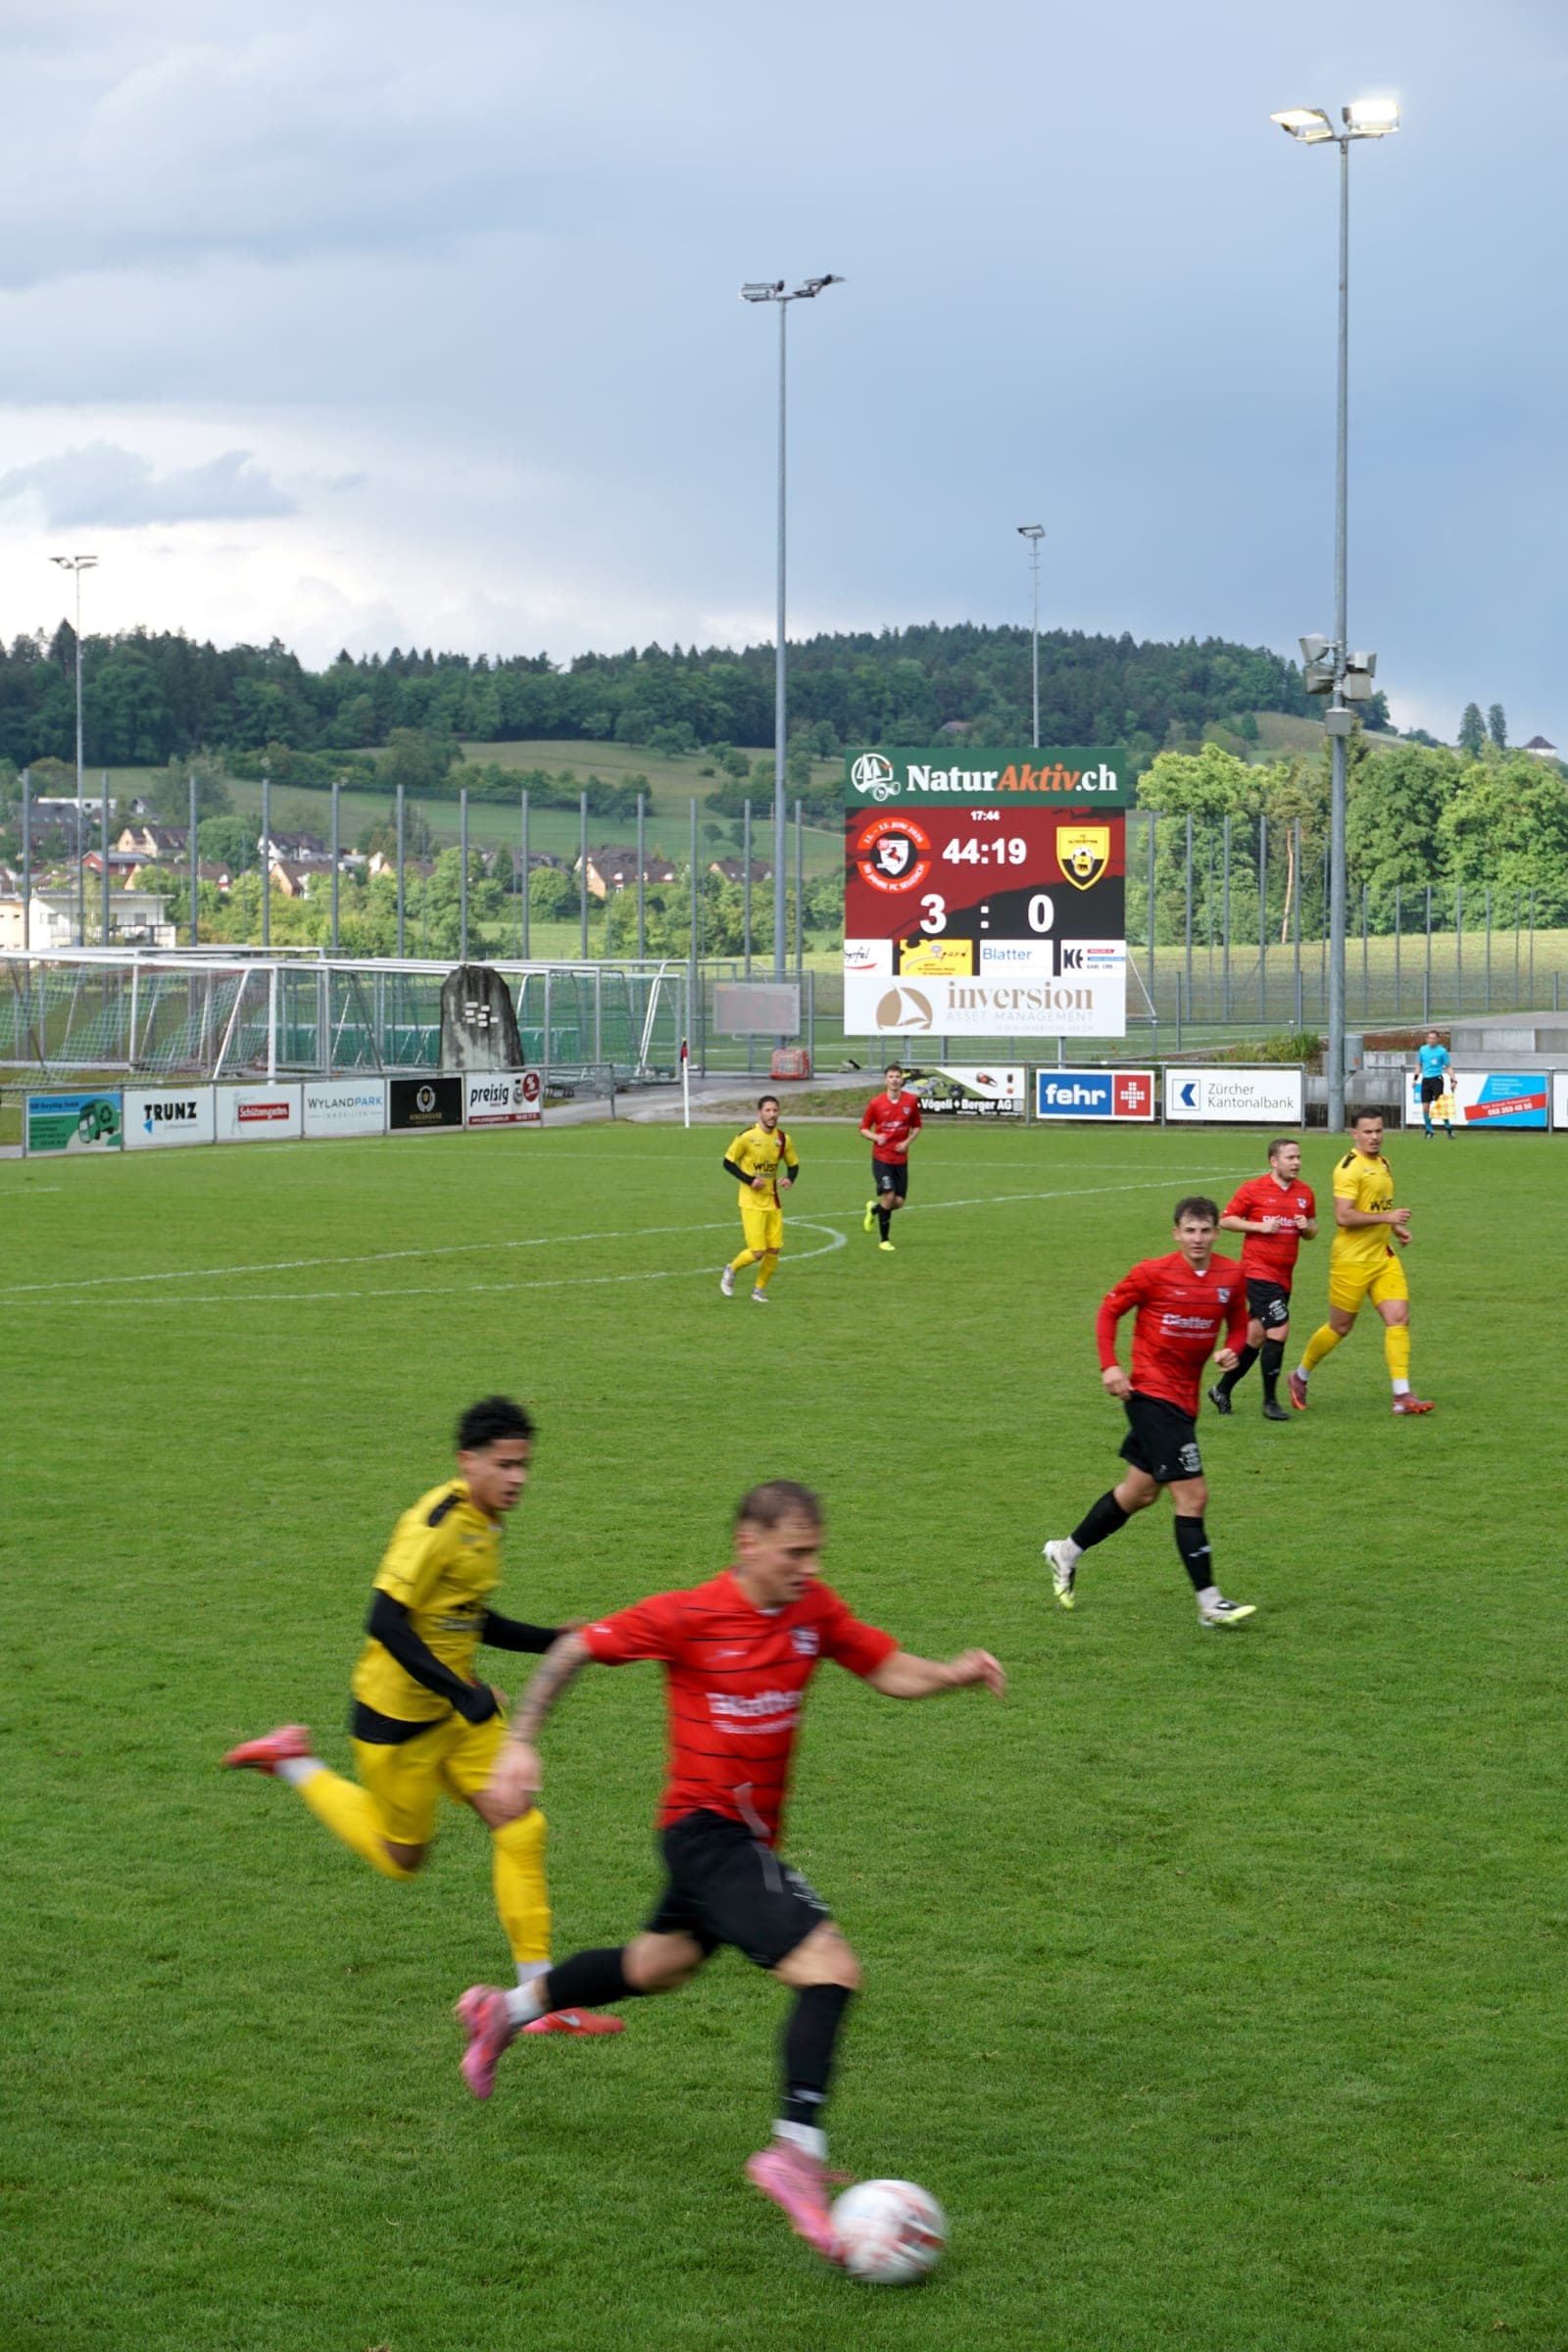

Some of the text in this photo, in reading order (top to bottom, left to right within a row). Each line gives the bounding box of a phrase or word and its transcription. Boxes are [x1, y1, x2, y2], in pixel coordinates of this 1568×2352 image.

[906, 763, 1117, 792] NaturAktiv.ch
[970, 810, 1000, 821] 17:44
[942, 838, 1027, 864] 44:19
[919, 894, 1054, 934] 3 : 0
[982, 948, 1032, 960] Blatter
[948, 981, 1094, 1009] inversion
[947, 1010, 1095, 1021] ASSET MANAGEMENT
[470, 1083, 510, 1107] preisig
[1045, 1083, 1106, 1105] fehr
[1207, 1083, 1255, 1096] Zürcher
[307, 1096, 383, 1109] WYLANDPARK
[921, 1098, 953, 1111] Vögeli
[961, 1099, 996, 1111] Berger
[997, 1099, 1012, 1110] AG
[1207, 1096, 1294, 1109] Kantonalbank
[144, 1102, 196, 1121] TRUNZ
[1162, 1313, 1215, 1329] Blatter
